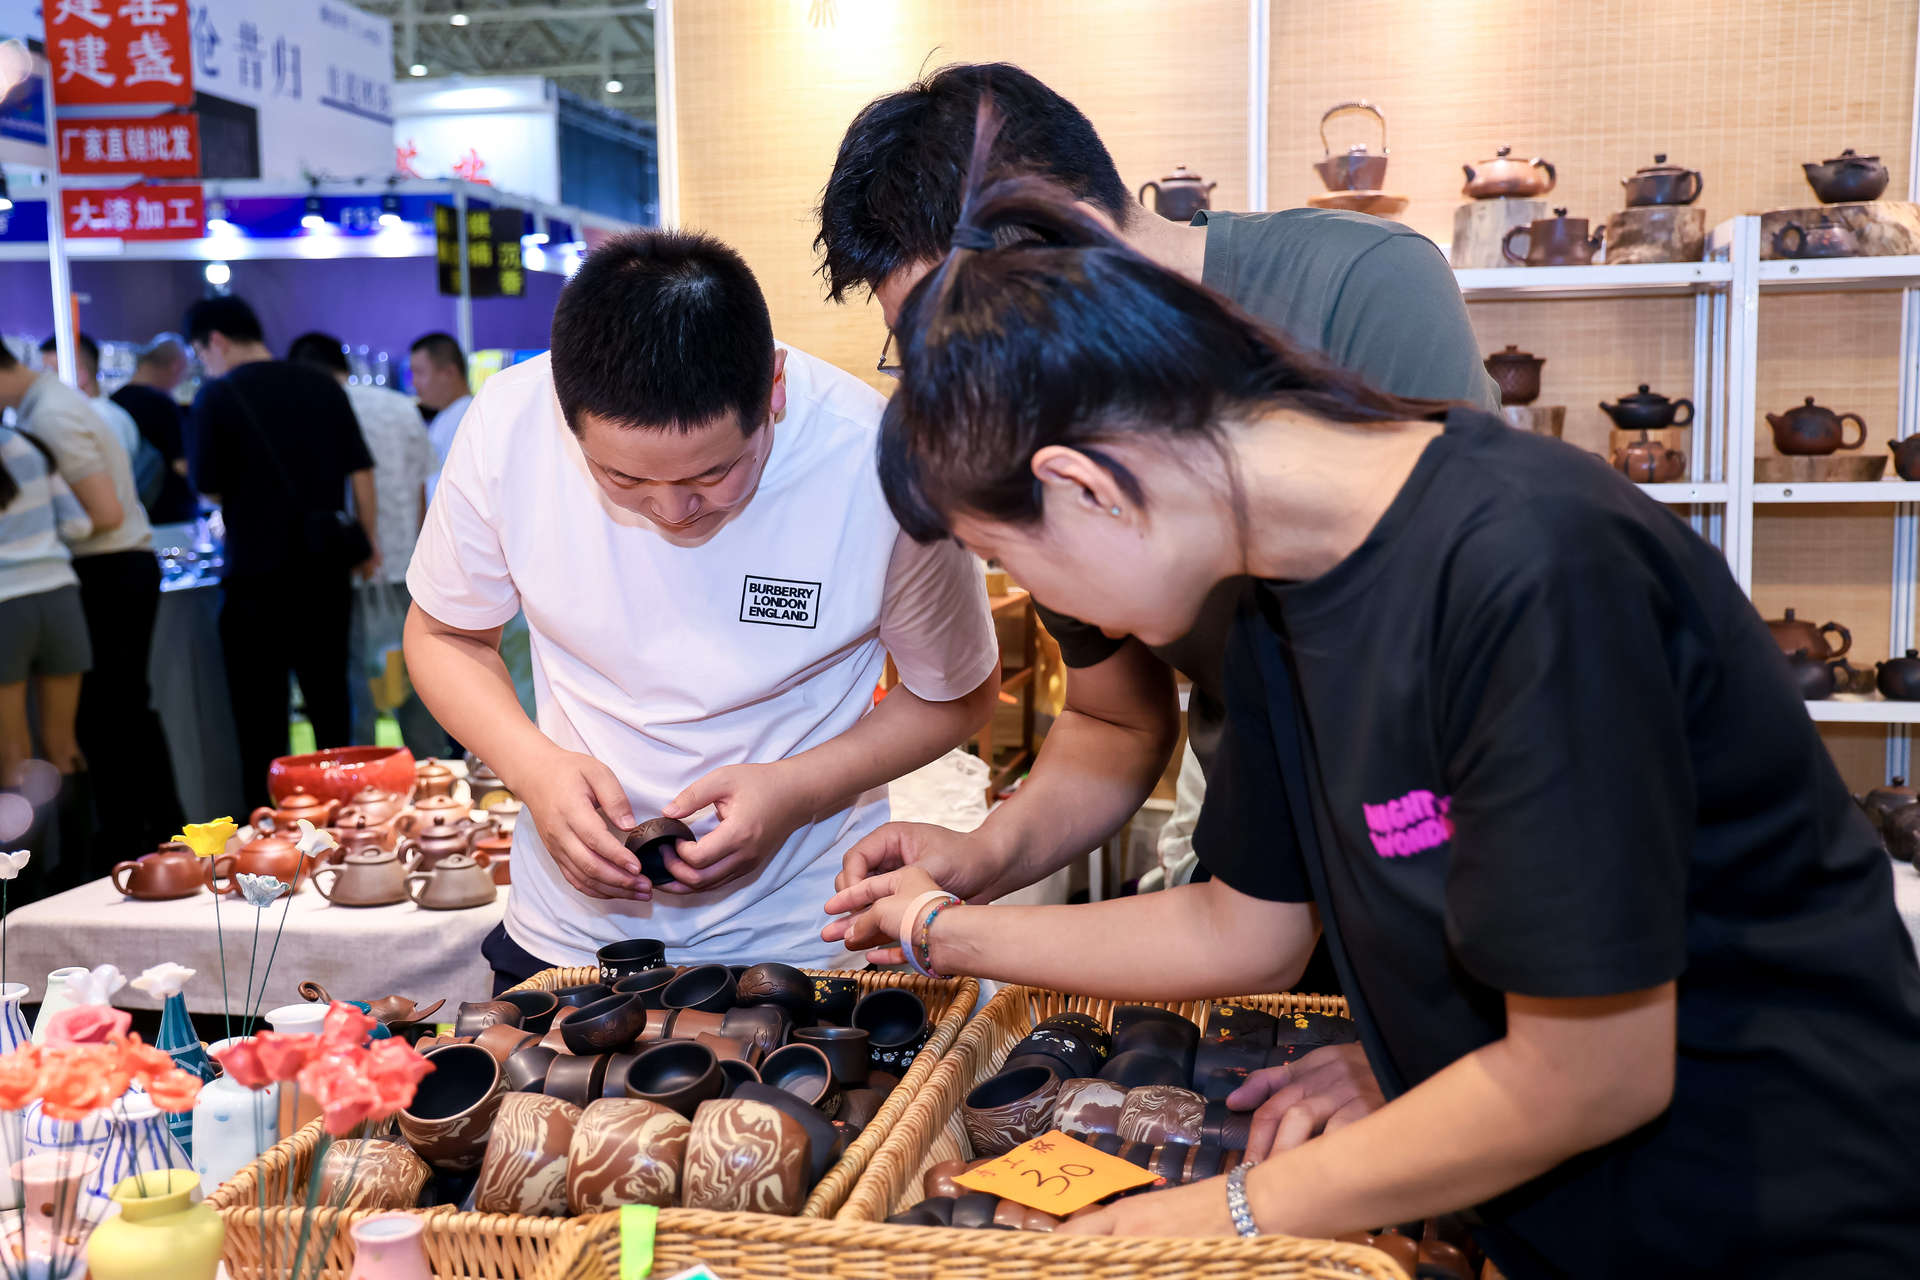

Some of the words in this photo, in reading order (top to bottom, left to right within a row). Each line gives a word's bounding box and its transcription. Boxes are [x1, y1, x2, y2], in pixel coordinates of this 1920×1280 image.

[57, 31, 183, 87] 建盏
[62, 126, 192, 161] 厂家直销批发
[70, 197, 196, 231] 大漆加工
[749, 583, 814, 599] BURBERRY
[753, 595, 807, 610] LONDON
[749, 606, 808, 621] ENGLAND
[1020, 1163, 1095, 1196] 30
